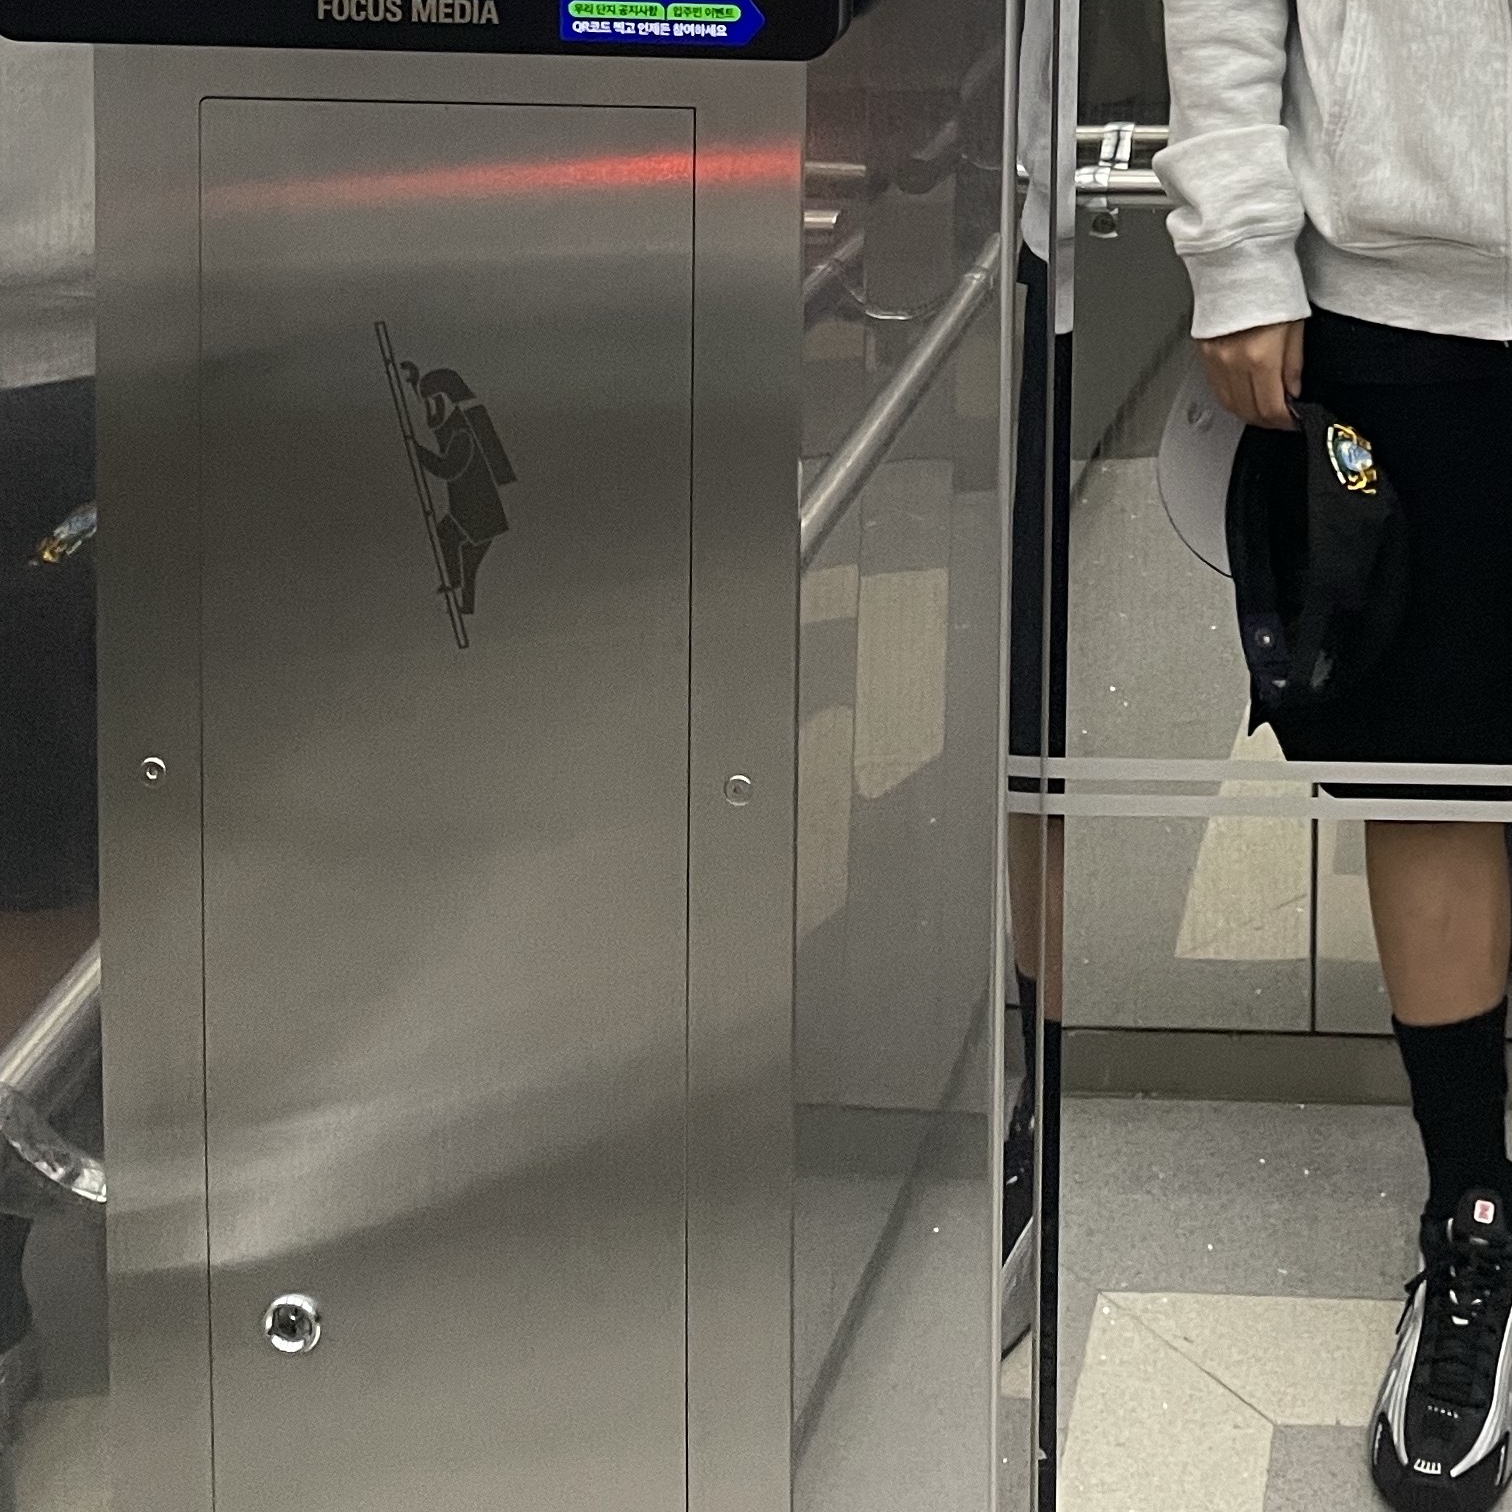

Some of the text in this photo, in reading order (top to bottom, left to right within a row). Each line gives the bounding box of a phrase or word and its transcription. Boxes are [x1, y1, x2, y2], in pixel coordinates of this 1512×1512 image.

[575, 3, 593, 14] 우리
[596, 4, 615, 15] 단지
[572, 21, 611, 33] QR코드
